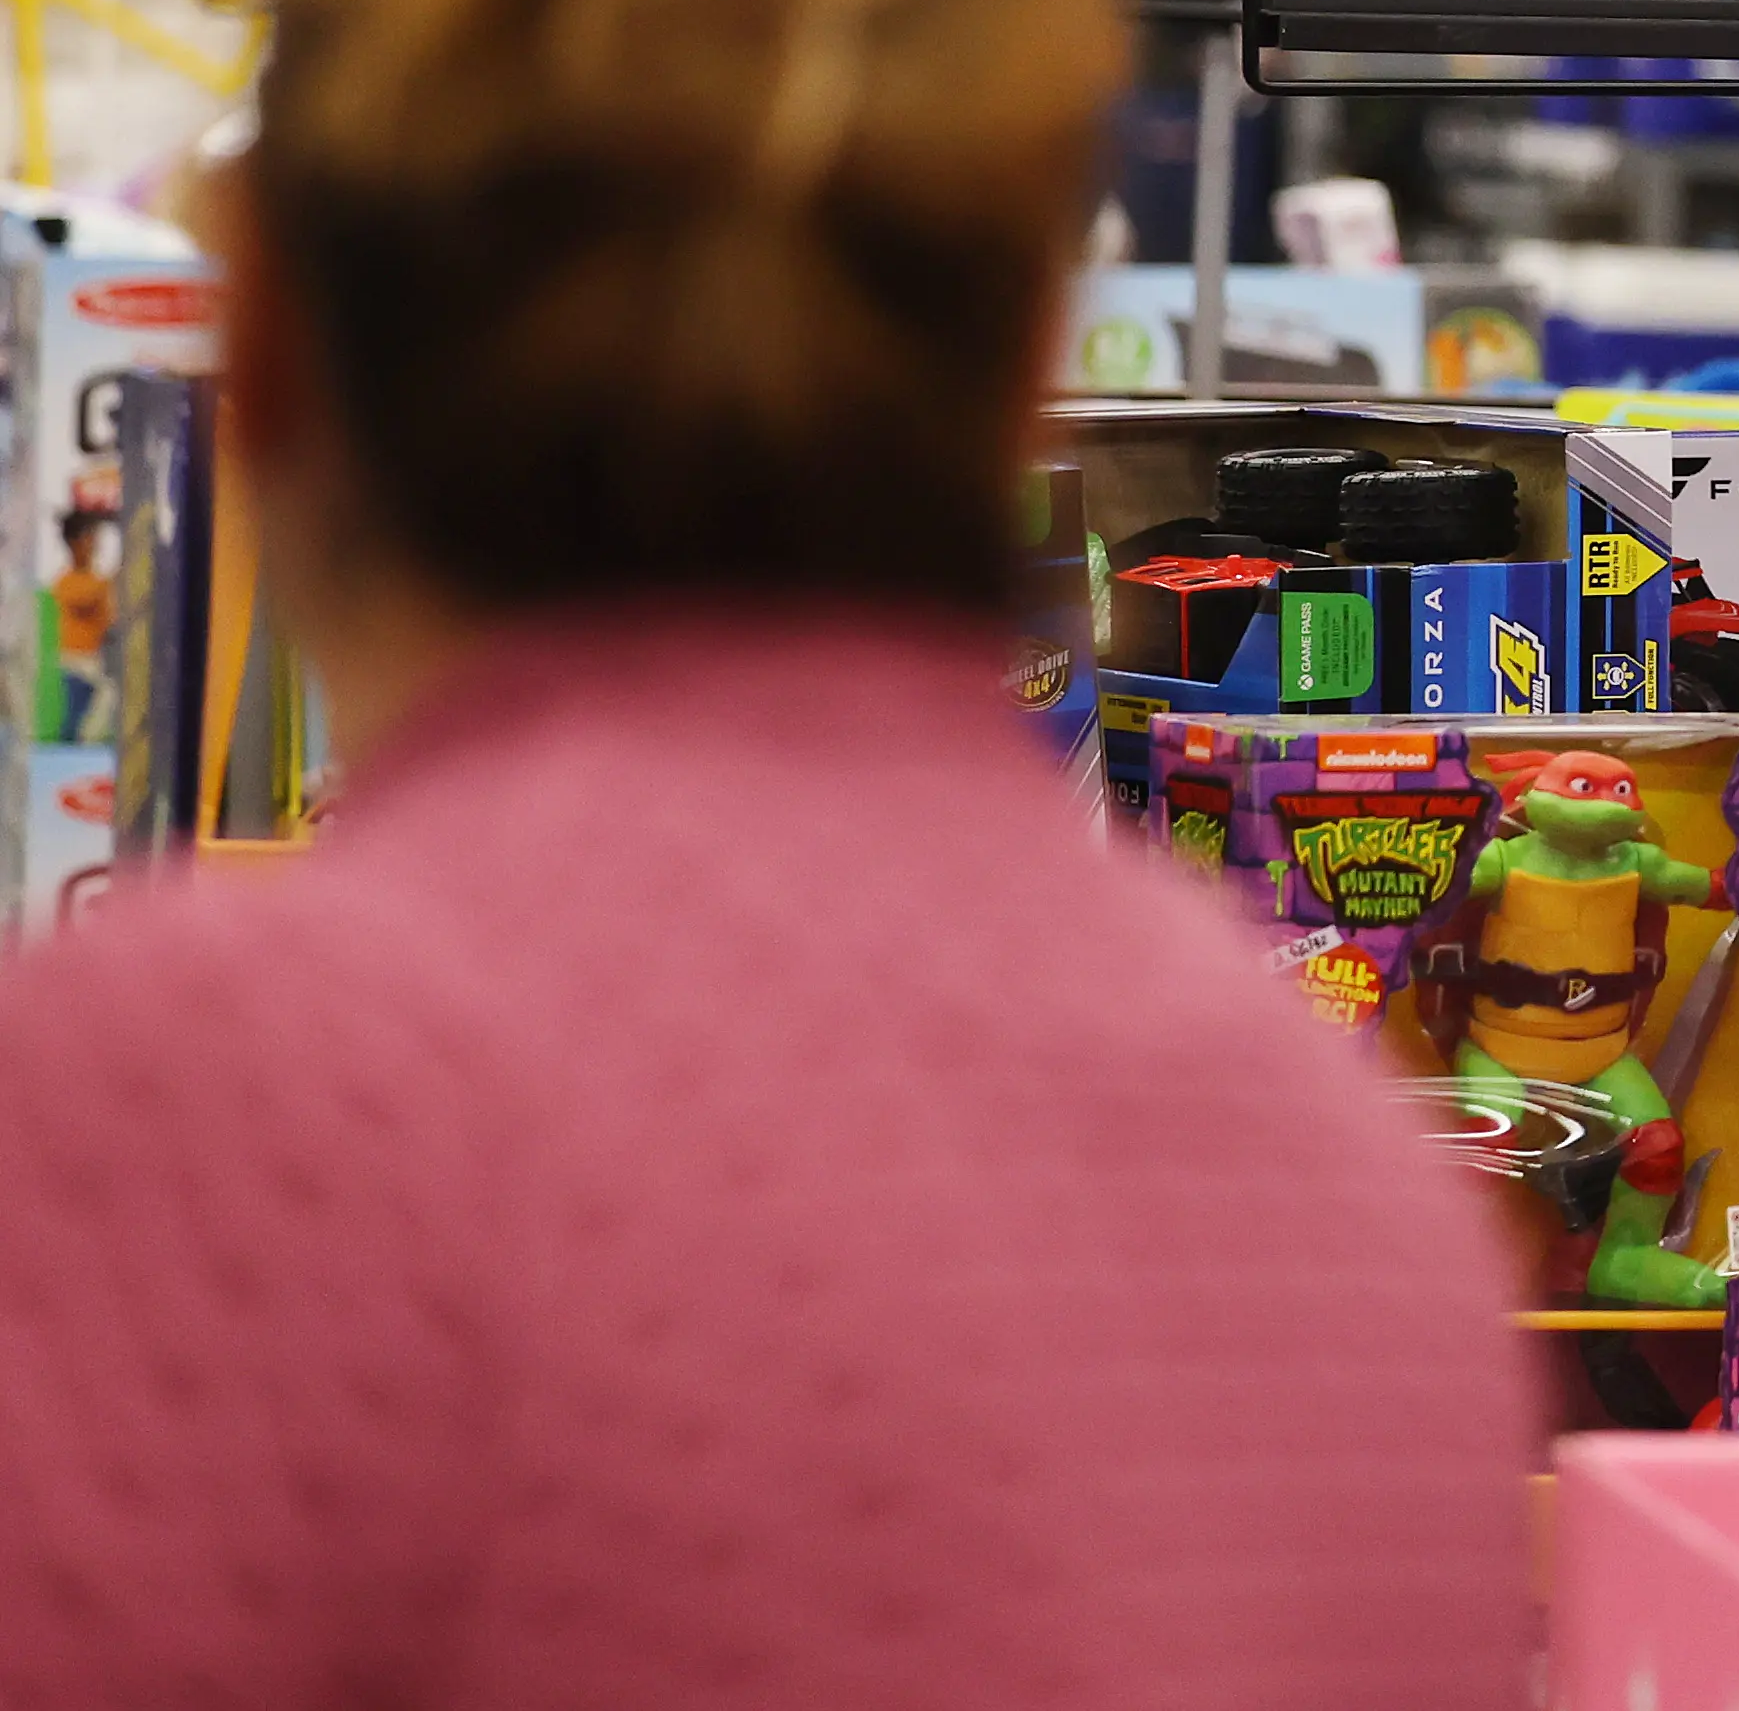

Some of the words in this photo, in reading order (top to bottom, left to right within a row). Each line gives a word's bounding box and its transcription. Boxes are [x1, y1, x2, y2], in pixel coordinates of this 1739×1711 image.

[1588, 540, 1611, 589] RTR
[1301, 601, 1312, 635] PASS
[1301, 635, 1312, 673] GAME
[1293, 816, 1466, 904] TURTLES
[1338, 868, 1428, 896] MUTANT
[1345, 896, 1421, 921] MAYHEM
